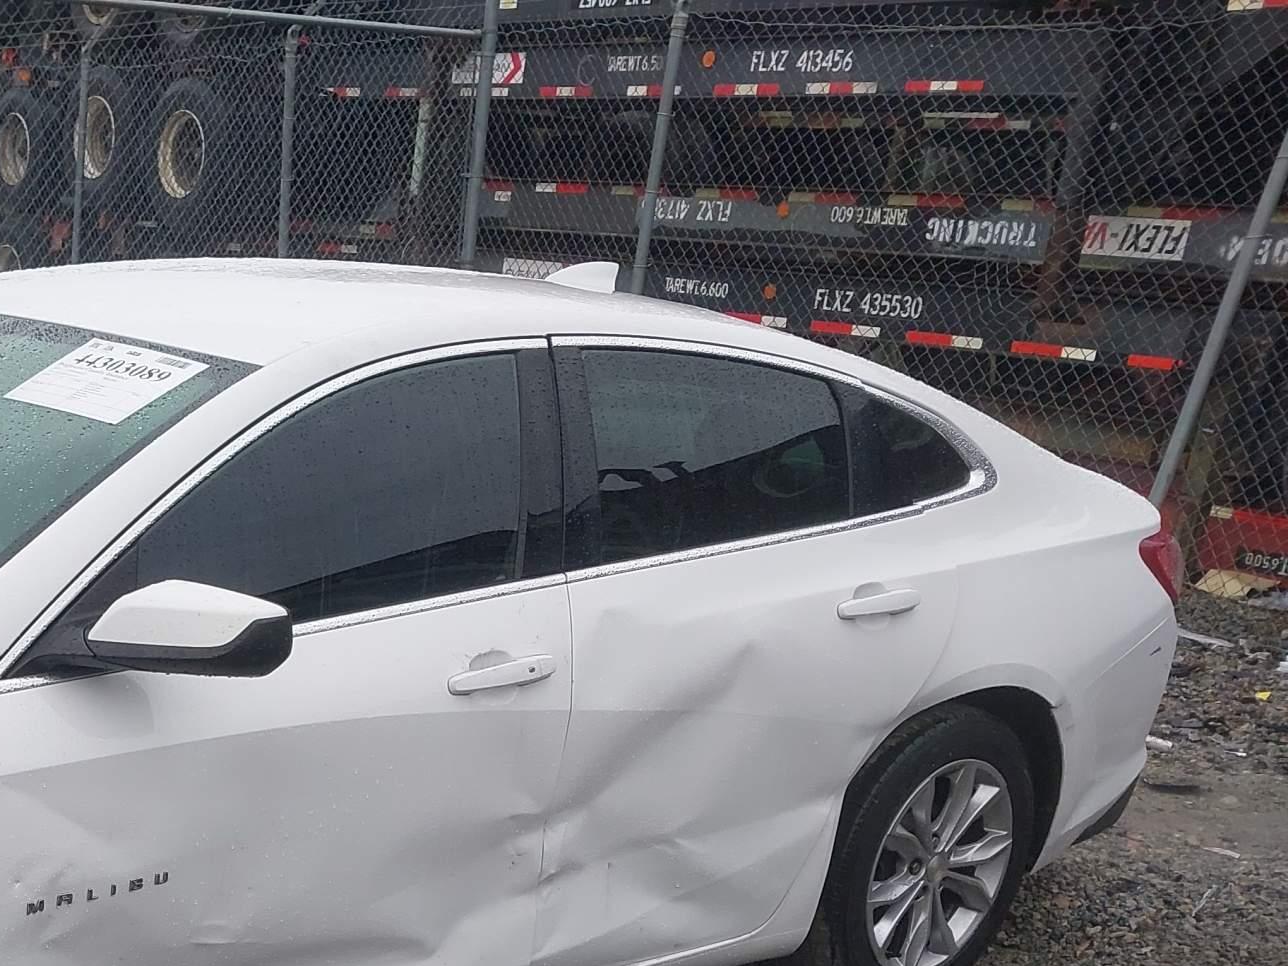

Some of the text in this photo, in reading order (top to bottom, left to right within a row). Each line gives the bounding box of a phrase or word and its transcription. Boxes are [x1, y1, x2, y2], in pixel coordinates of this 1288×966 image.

[750, 49, 854, 72] FLXZ 413456
[696, 200, 732, 222] FLXZ
[925, 217, 1037, 248] TRUCKING
[813, 288, 923, 319] FLXZ 435530
[74, 353, 172, 382] 44303089
[26, 872, 169, 916] MALIBU
